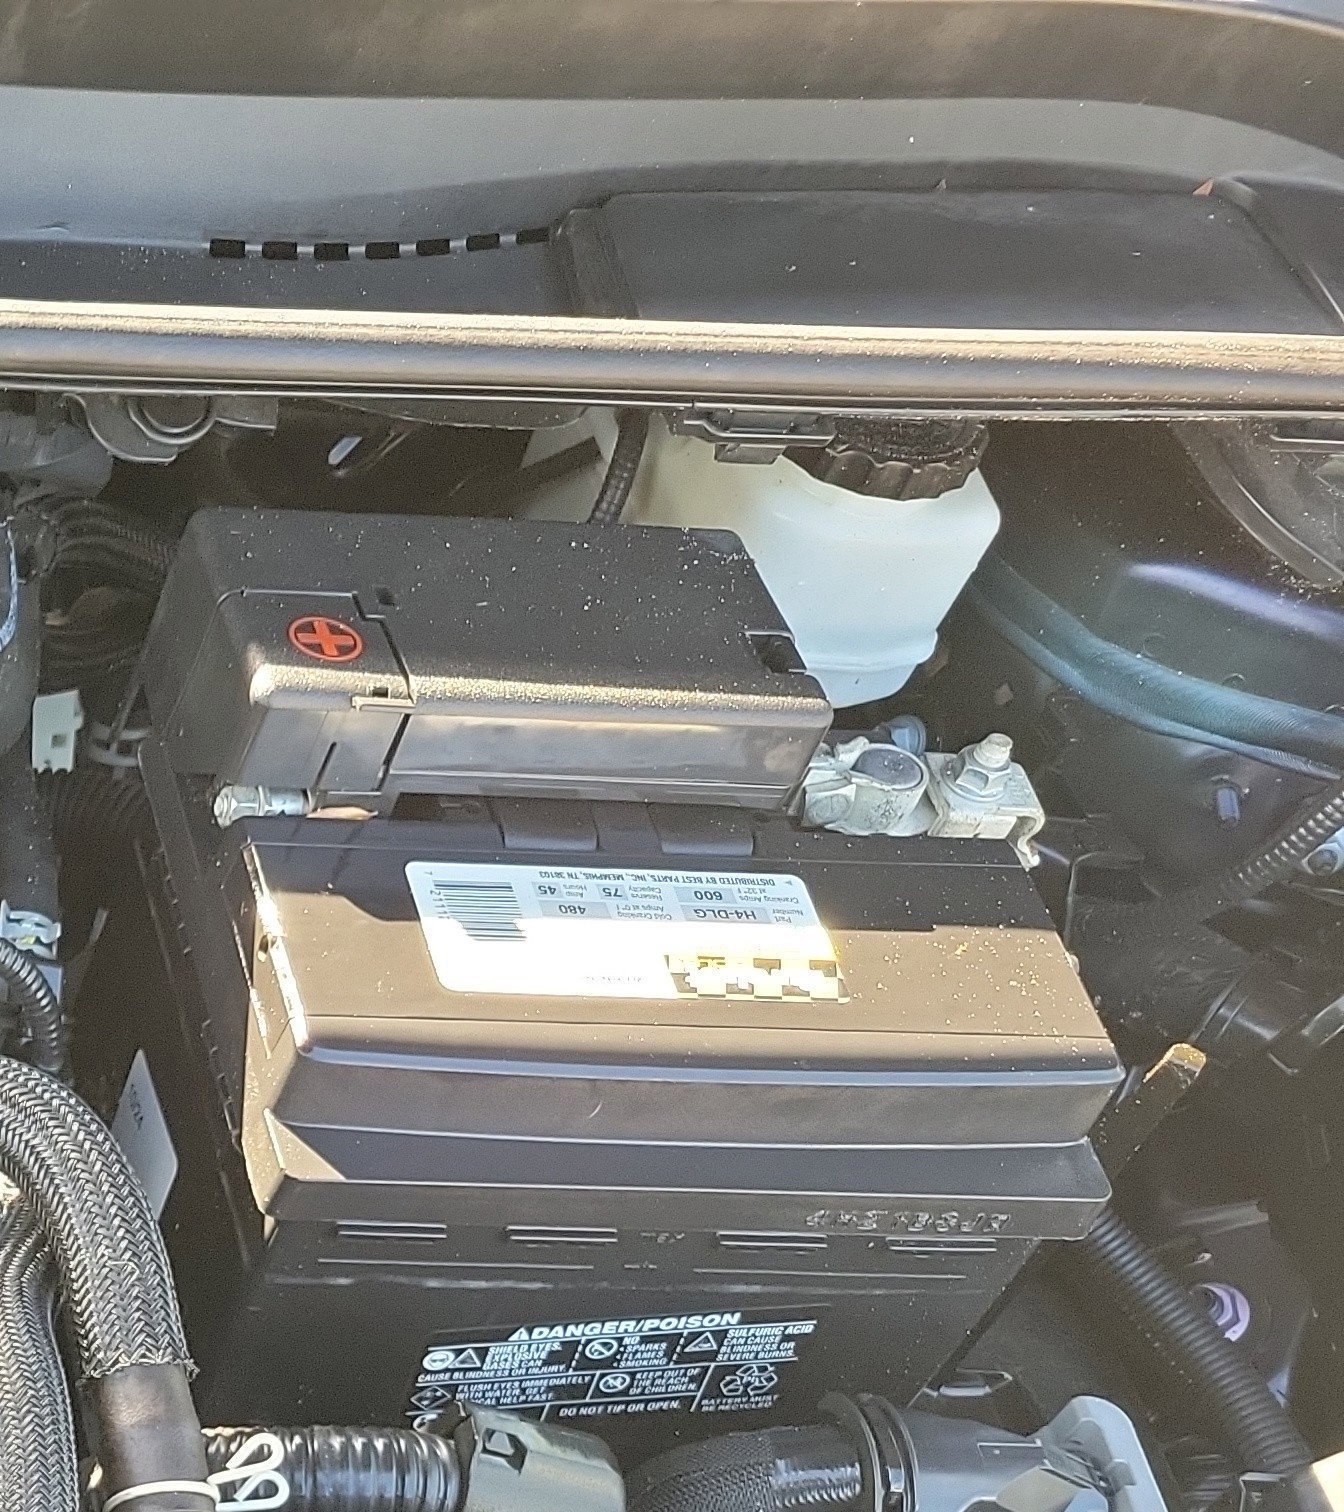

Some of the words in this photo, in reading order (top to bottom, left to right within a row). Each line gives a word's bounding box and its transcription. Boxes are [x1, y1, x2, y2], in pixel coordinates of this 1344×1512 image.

[567, 872, 579, 880] TN
[681, 876, 702, 884] BEST
[705, 877, 717, 885] BY
[719, 877, 775, 886] DISTRIBUTED
[538, 885, 557, 895] 45
[566, 890, 584, 898] Amp
[602, 887, 622, 897] 75
[628, 885, 662, 894] Capacity
[631, 893, 662, 901] Reserve
[694, 890, 722, 901] 600
[739, 895, 762, 903] Amps
[764, 895, 799, 905] Cranking
[558, 904, 586, 914] 480
[693, 908, 757, 920] H4-DLG
[772, 908, 804, 916] Number
[618, 911, 652, 920] Cranking
[774, 916, 792, 924] Part
[531, 1312, 742, 1339] DANGER/POISON
[726, 1327, 784, 1338] SULFURIC
[784, 1325, 815, 1334] ACID
[622, 1336, 640, 1345] NO
[723, 1337, 746, 1346] CAN
[747, 1335, 781, 1344] CAUSE
[488, 1344, 529, 1354] SHIELD
[625, 1342, 668, 1352] SPARKS
[719, 1343, 779, 1354] BLINDNESS
[780, 1341, 796, 1349] OR
[484, 1350, 549, 1362] EXPLOSIVE
[622, 1351, 664, 1360] FLAMES
[716, 1351, 759, 1361] SEVERE
[482, 1360, 519, 1370] GASES
[522, 1359, 543, 1368] CAN
[619, 1359, 668, 1368] SMOKING
[417, 1373, 451, 1382] CAUSE
[452, 1370, 509, 1381] BLINDNESS
[511, 1368, 527, 1376] OR
[528, 1365, 567, 1375] INJURY.
[635, 1370, 662, 1380] KEEP
[664, 1369, 685, 1378] OUT
[687, 1367, 702, 1376] OF
[457, 1384, 492, 1393] FLUSH
[493, 1381, 520, 1390] EYES
[521, 1376, 592, 1388] IMMEDIATELY
[632, 1380, 652, 1388] THE
[653, 1377, 690, 1386] REACH
[455, 1391, 483, 1400] WITH
[525, 1387, 547, 1395] GET
[628, 1386, 644, 1395] OF
[499, 1395, 526, 1404] HELP
[559, 1407, 576, 1417] DO
[579, 1406, 605, 1416] NOT
[606, 1404, 626, 1414] TIP
[627, 1403, 644, 1412] OR
